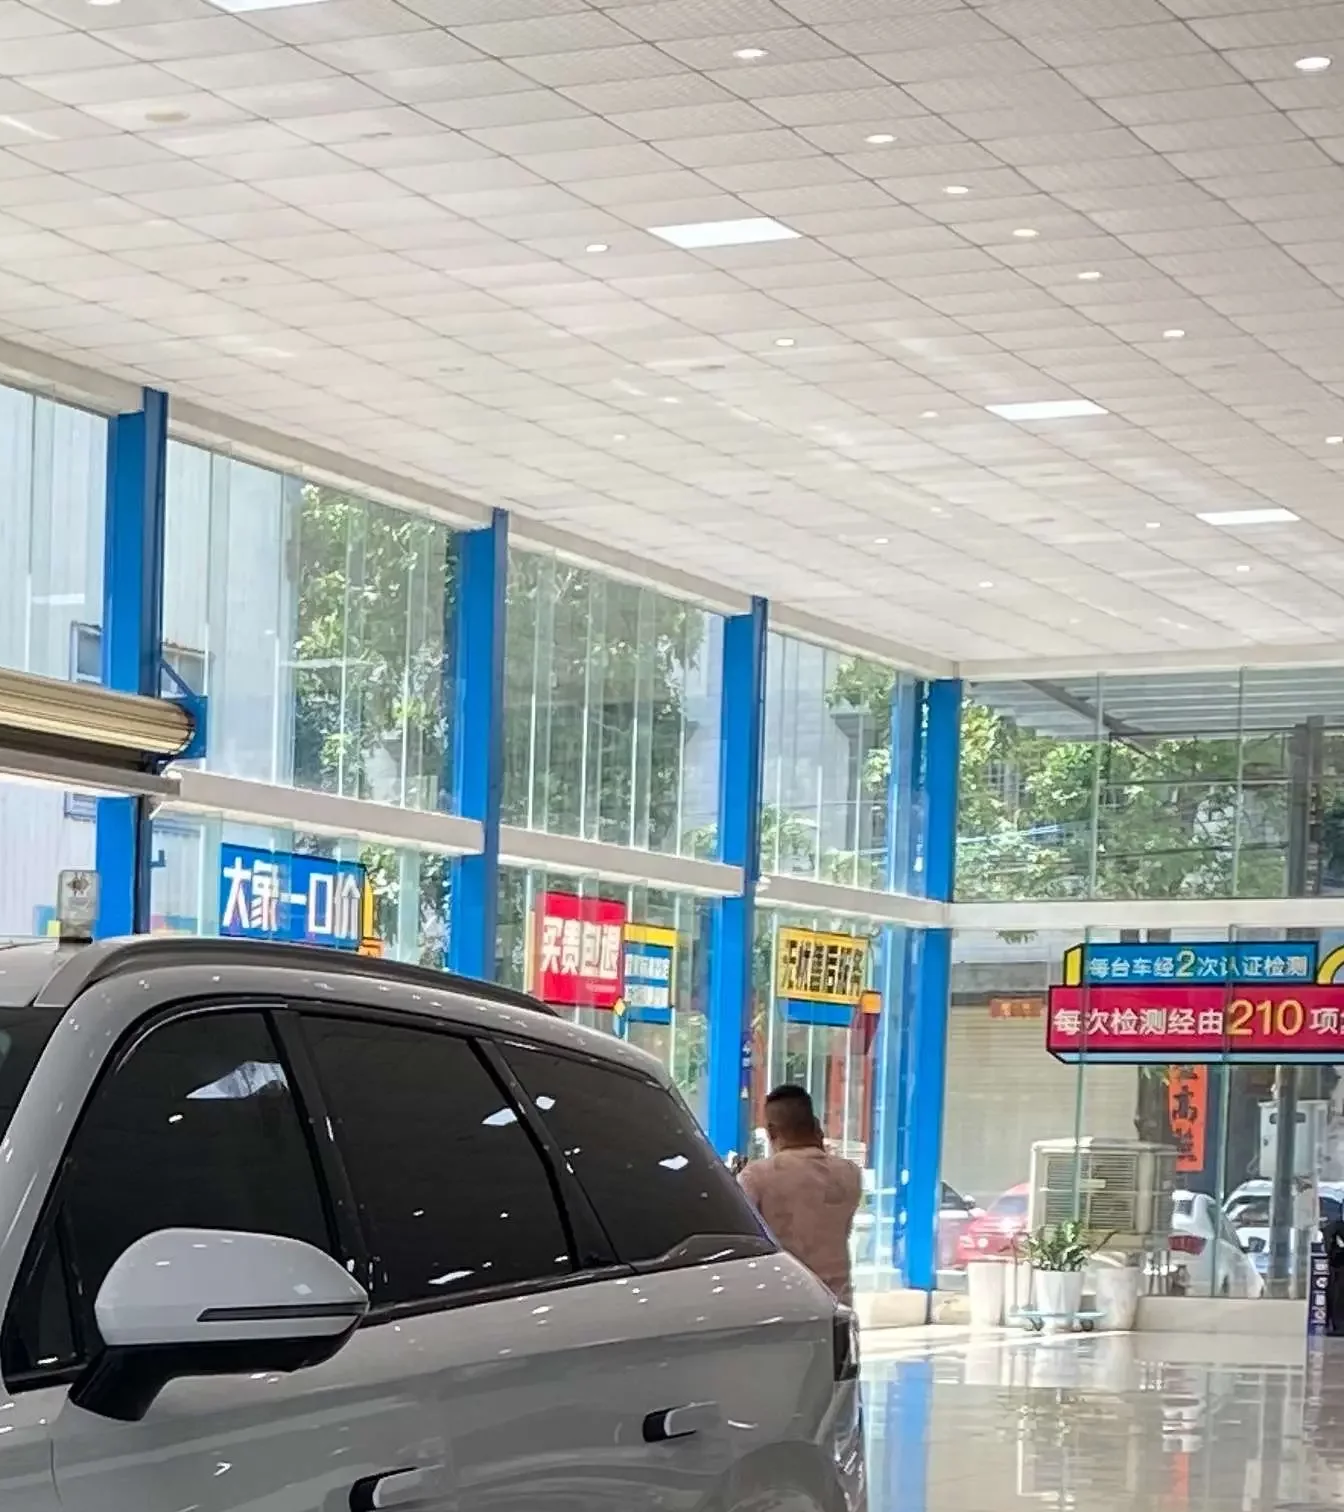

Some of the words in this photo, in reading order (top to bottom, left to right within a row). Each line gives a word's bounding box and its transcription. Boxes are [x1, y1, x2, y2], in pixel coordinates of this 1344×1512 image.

[223, 857, 361, 940] 大象一口价
[539, 915, 622, 980] 买贵包退
[1088, 950, 1308, 979] 每台车经2次认证检测
[1053, 999, 1344, 1037] 每次检测经由210项
